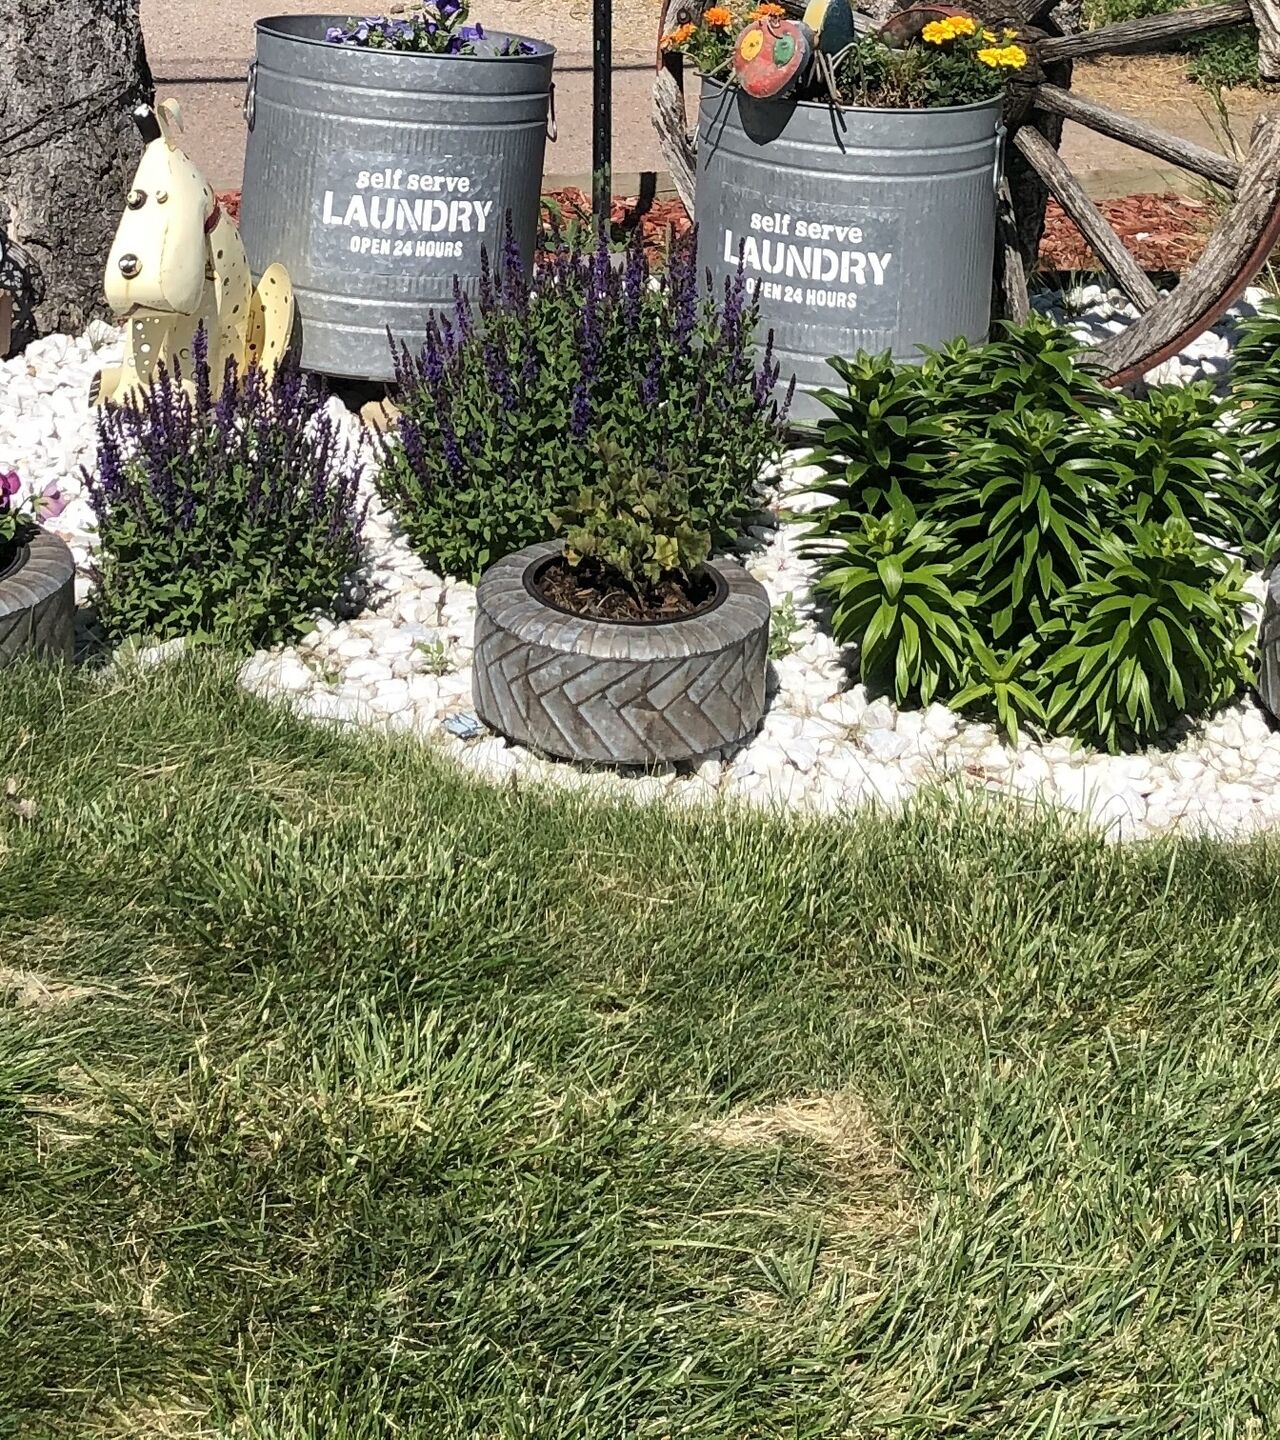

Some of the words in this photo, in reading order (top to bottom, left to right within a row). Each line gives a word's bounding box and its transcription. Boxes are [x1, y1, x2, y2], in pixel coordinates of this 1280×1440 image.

[356, 168, 402, 189] self
[407, 173, 470, 192] serve
[323, 190, 493, 232] LAUNDRY
[750, 212, 791, 235] self
[795, 220, 863, 243] serve
[350, 235, 390, 255] OPEN
[393, 239, 412, 256] 24
[416, 240, 463, 257] HOURS
[723, 229, 892, 286] LAUNDRY
[783, 285, 803, 304] 24
[805, 288, 858, 308] HOURS
